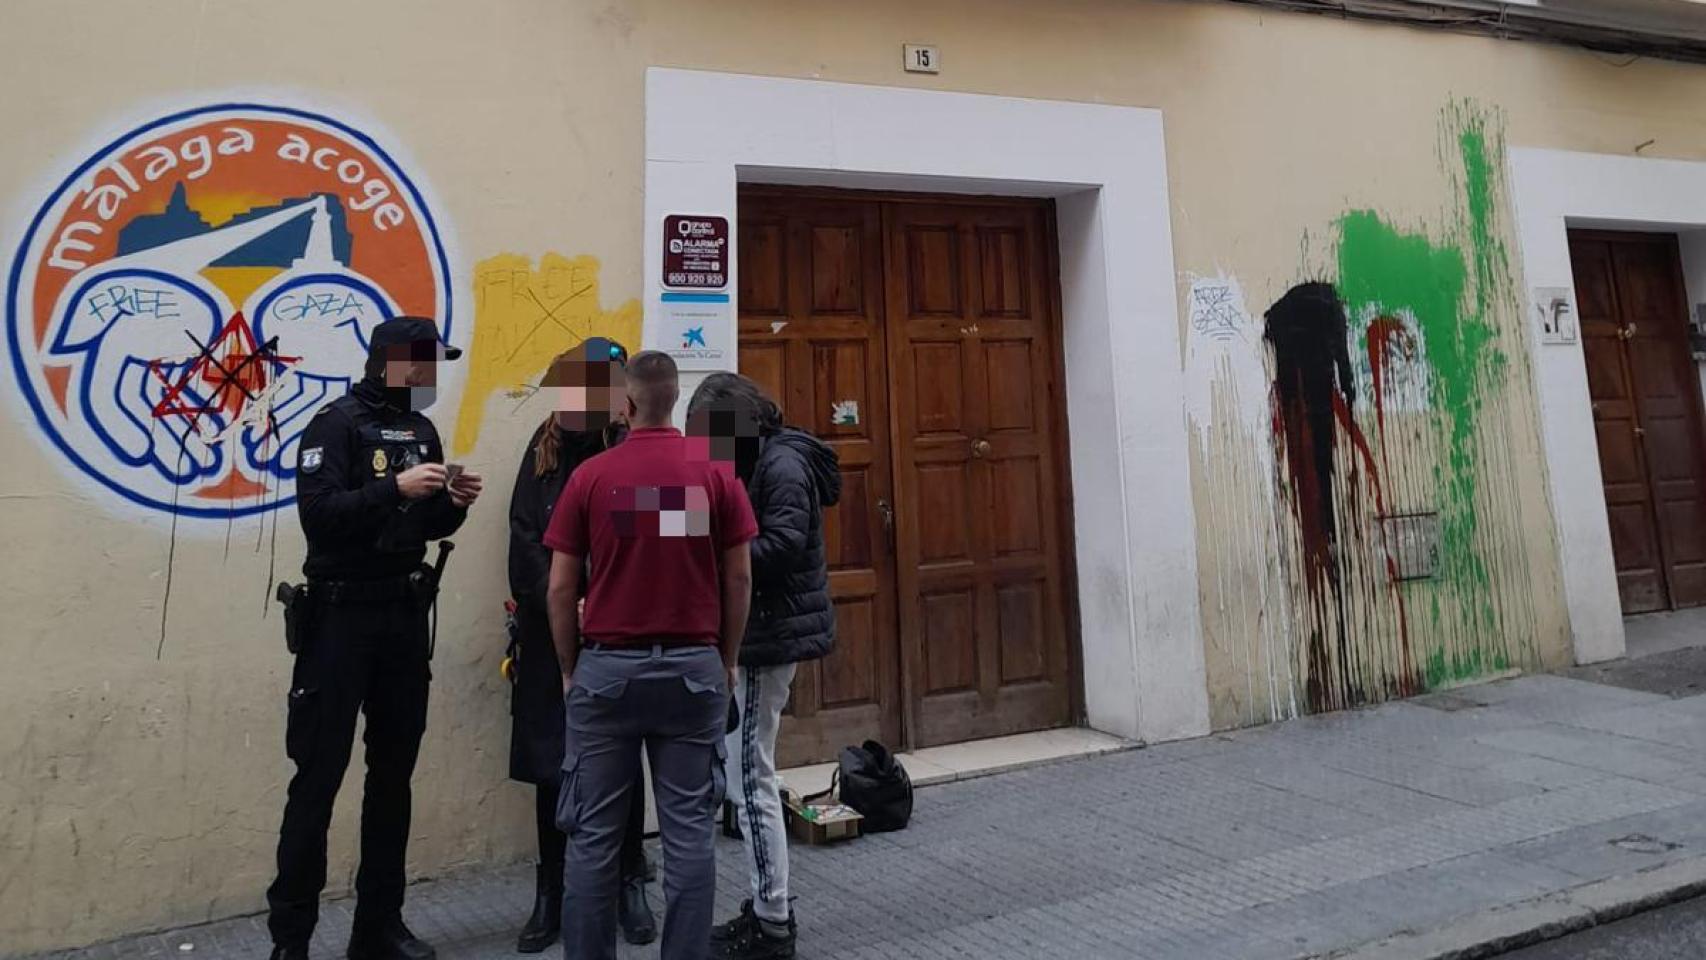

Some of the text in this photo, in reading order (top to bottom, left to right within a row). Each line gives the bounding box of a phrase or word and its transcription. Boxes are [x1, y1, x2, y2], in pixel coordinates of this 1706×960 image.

[915, 49, 929, 67] 15
[277, 133, 407, 232] acoge
[683, 239, 720, 247] ALARMA
[668, 273, 724, 285] 900 920 920
[88, 285, 365, 323] FREE GAZA
